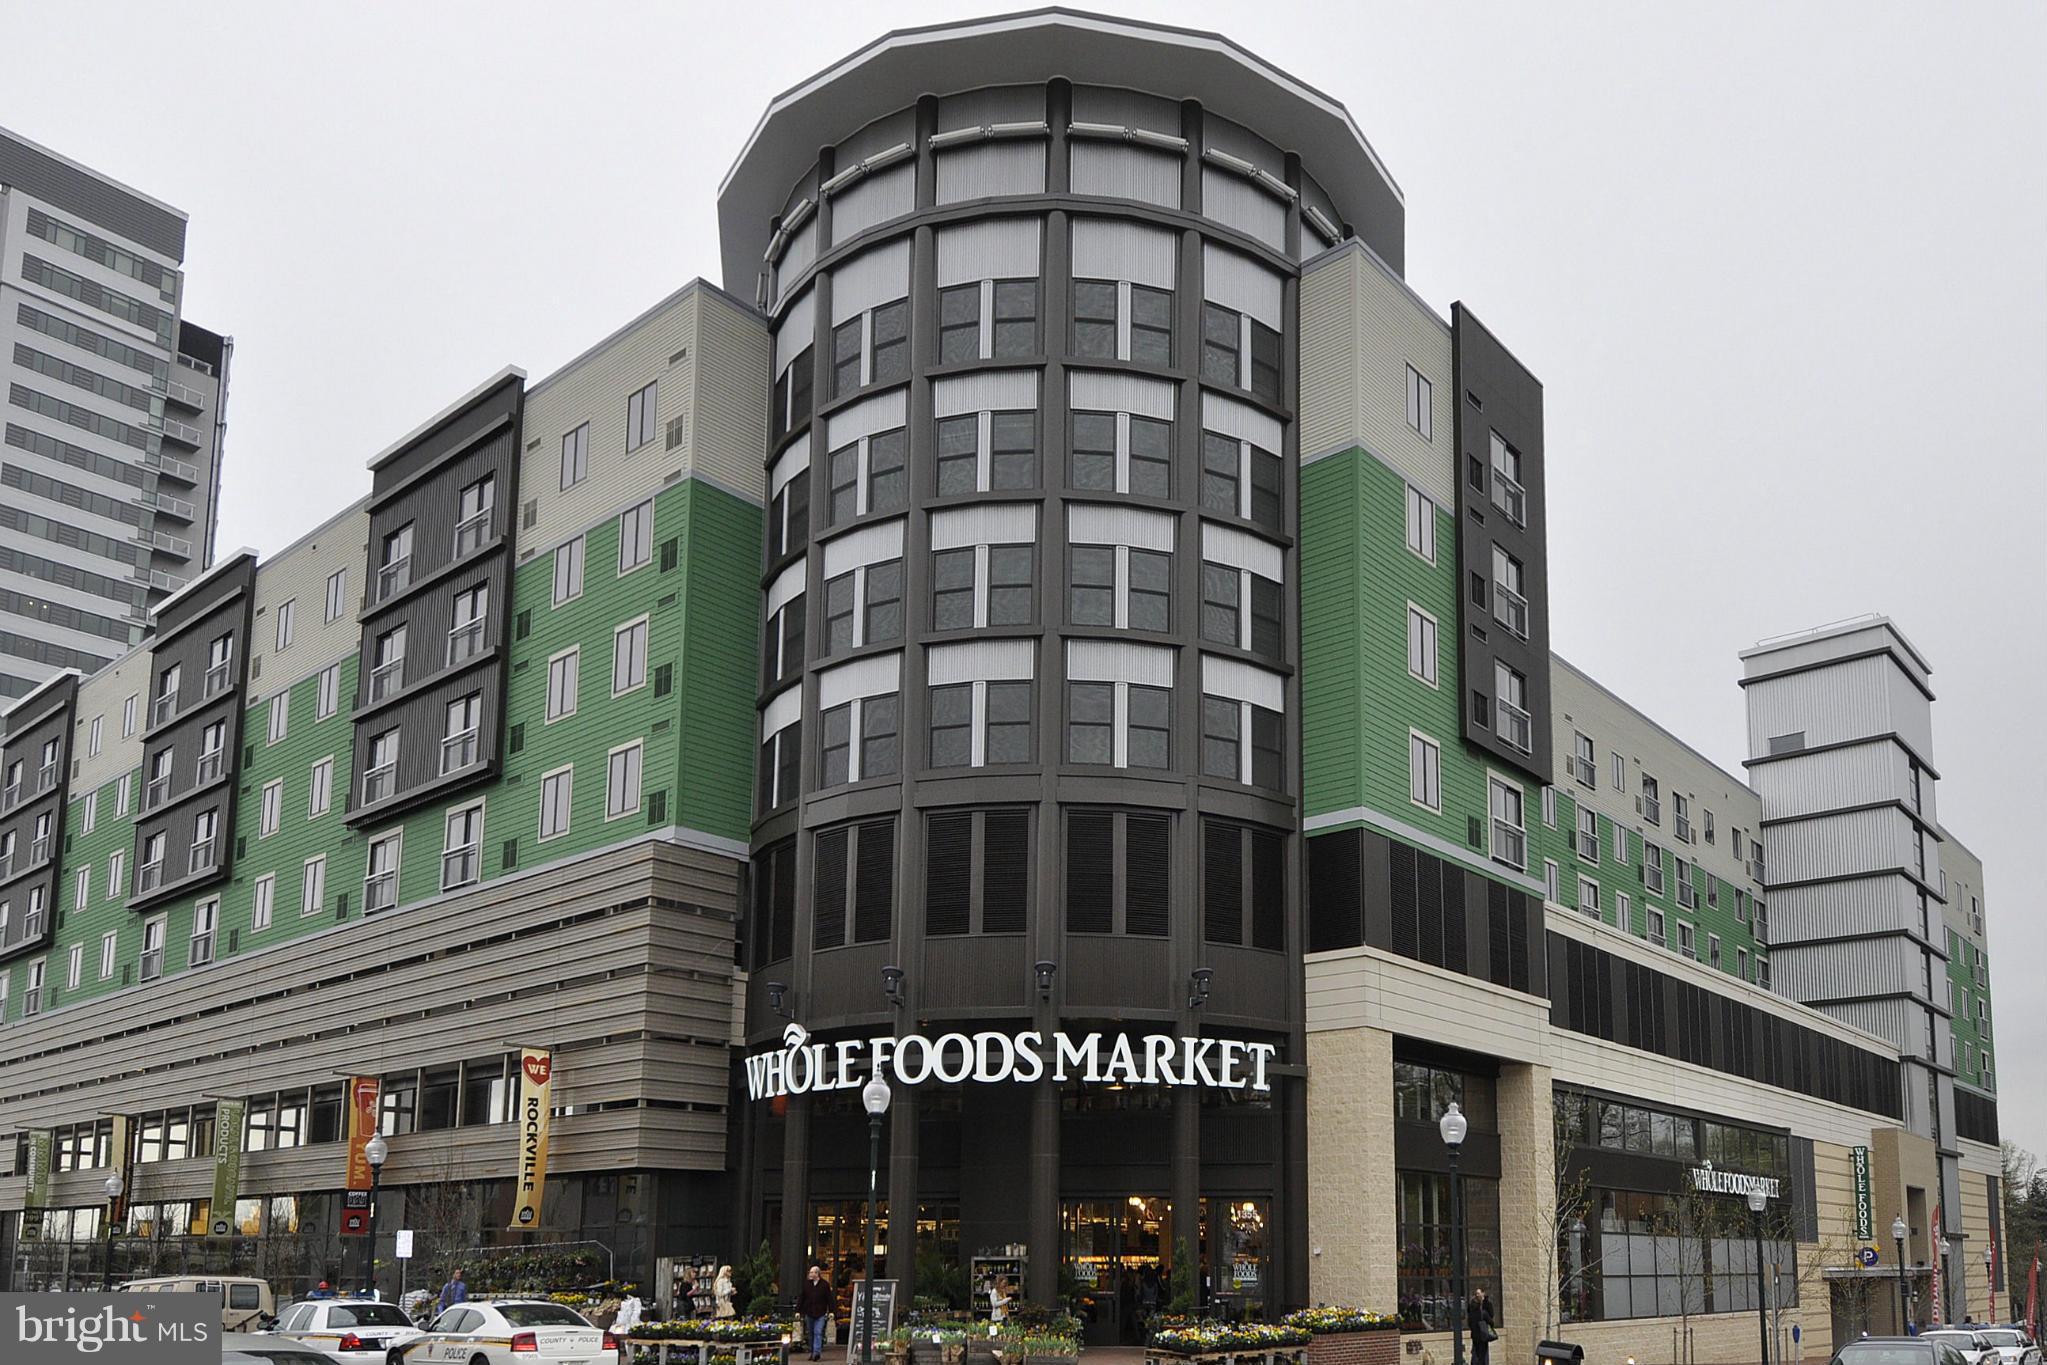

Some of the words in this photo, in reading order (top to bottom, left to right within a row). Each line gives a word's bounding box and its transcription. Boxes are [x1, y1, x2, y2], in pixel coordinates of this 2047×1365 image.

[528, 1063, 547, 1075] WE
[745, 1023, 864, 1101] WHOLE
[869, 1031, 1042, 1084] FOODS
[1053, 1033, 1275, 1091] MARKET
[218, 1108, 231, 1164] PRODUCTS
[523, 1097, 538, 1191] ROCKVILLE
[1693, 1160, 1725, 1193] WHOLE
[1723, 1172, 1751, 1195] FOODS
[1855, 1147, 1866, 1191] WHOLE
[1858, 1193, 1868, 1235] FOODS
[444, 1347, 468, 1359] POLICE
[540, 1337, 568, 1345] COUNTY
[577, 1335, 600, 1344] POLICE
